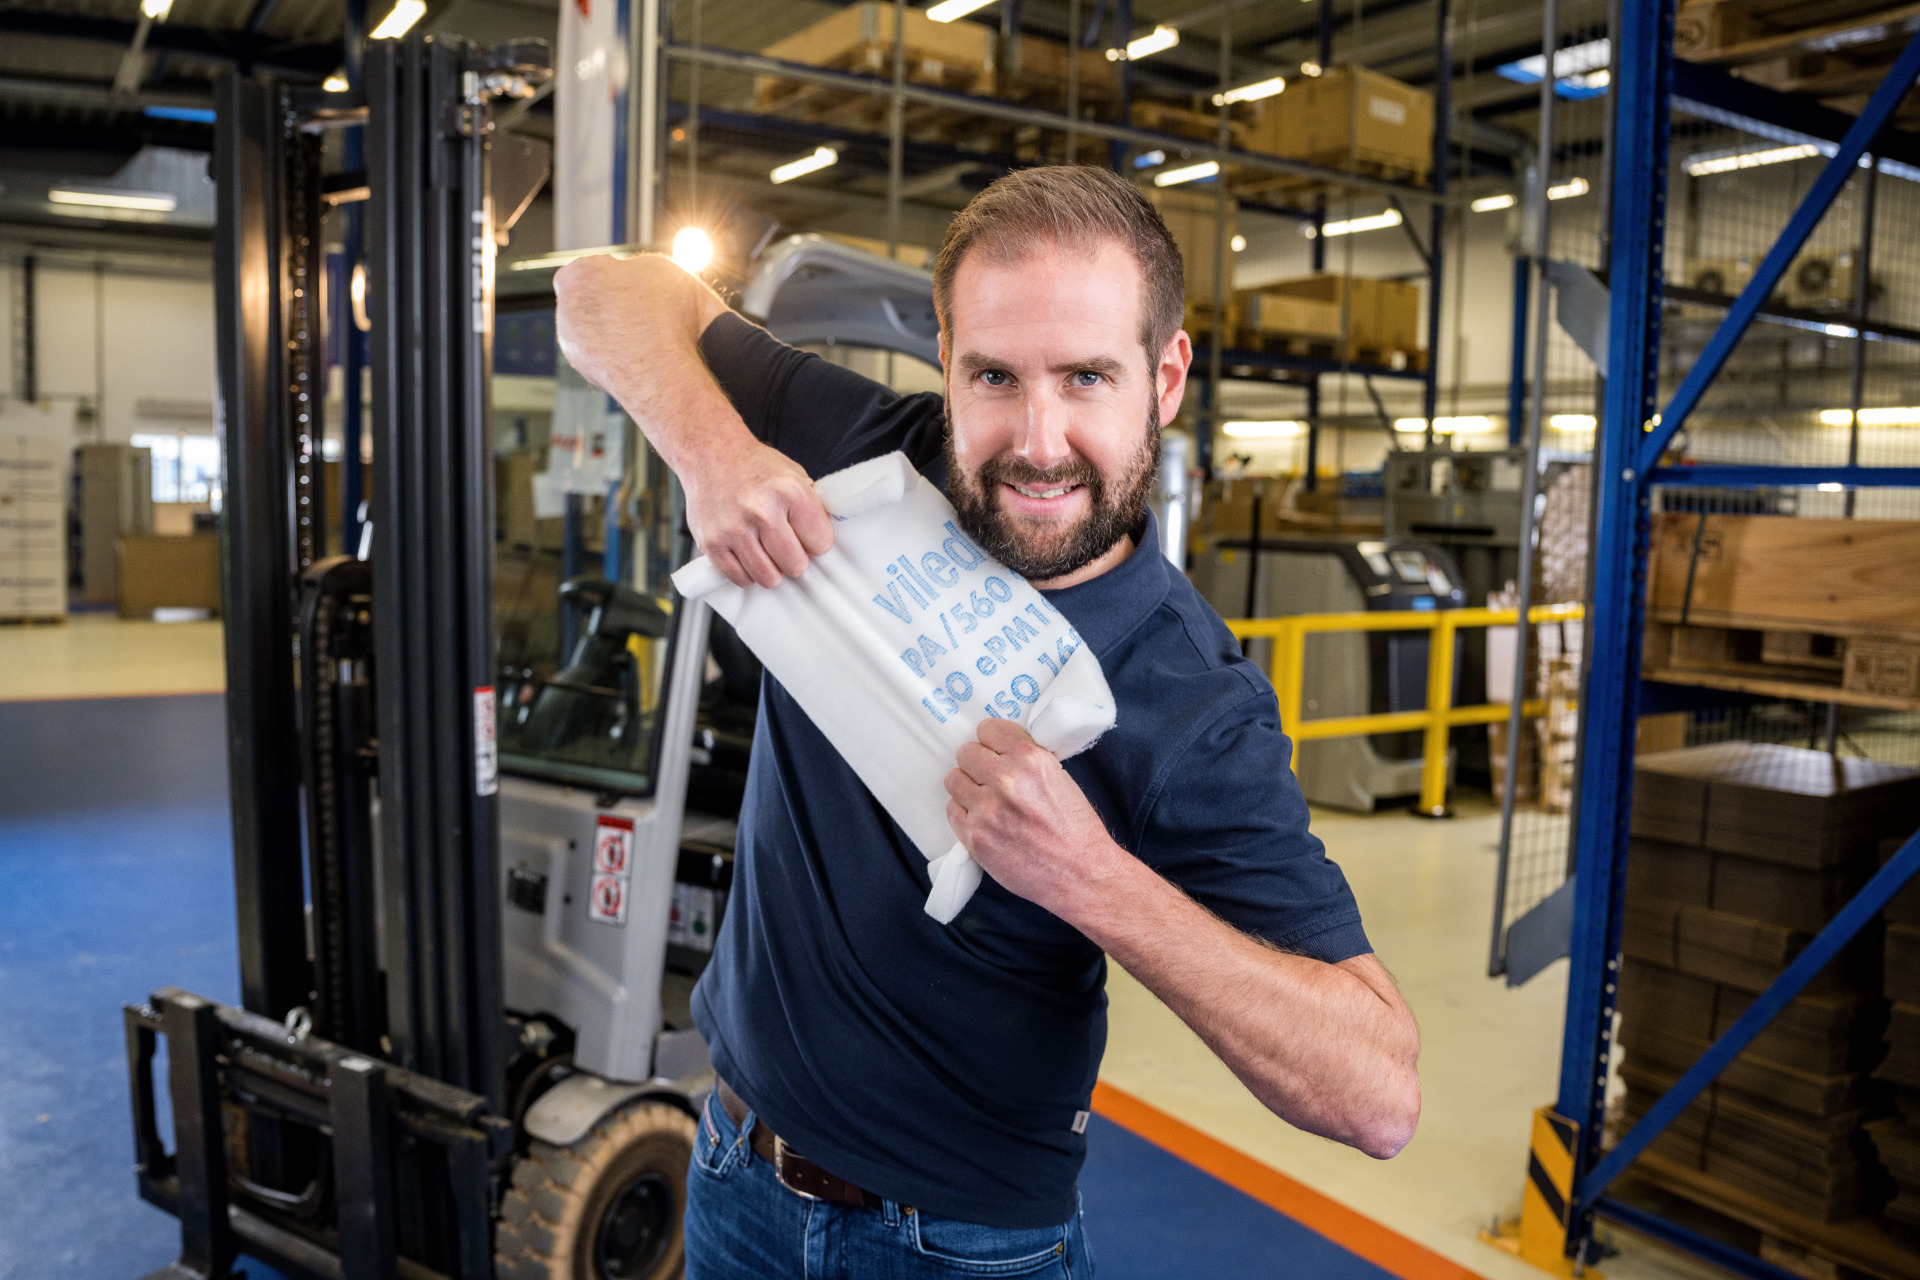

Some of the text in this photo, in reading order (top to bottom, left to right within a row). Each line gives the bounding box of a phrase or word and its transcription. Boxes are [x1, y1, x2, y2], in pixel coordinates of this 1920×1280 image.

[872, 520, 987, 624] viled
[900, 576, 1013, 679] PA/560
[922, 595, 1059, 724] ISO ePM1
[985, 674, 1040, 720] ISO
